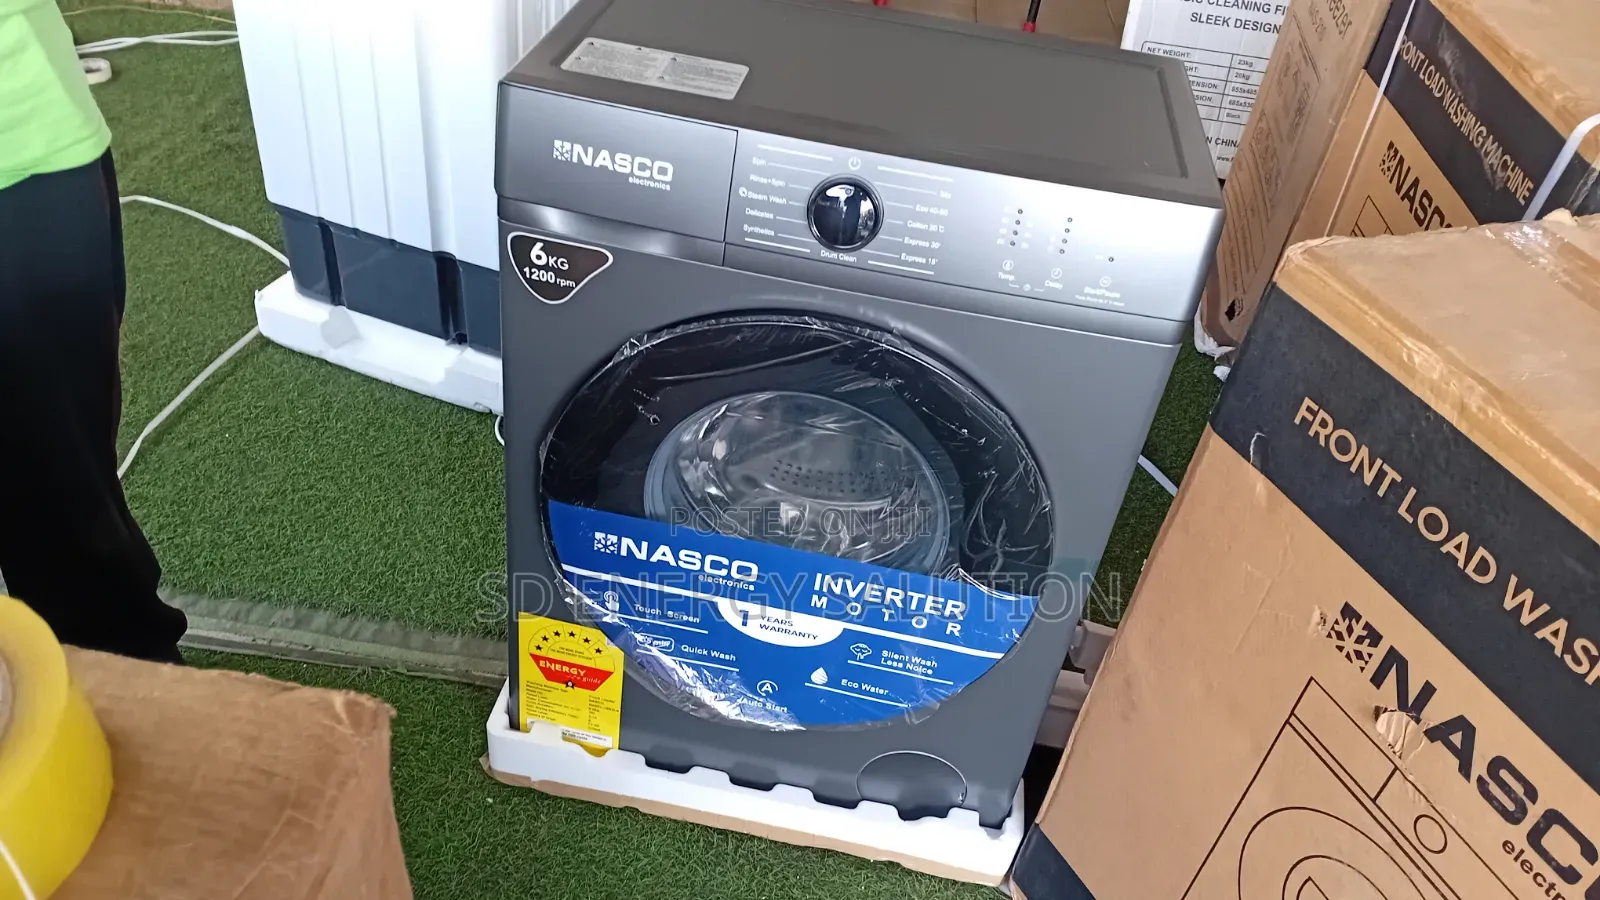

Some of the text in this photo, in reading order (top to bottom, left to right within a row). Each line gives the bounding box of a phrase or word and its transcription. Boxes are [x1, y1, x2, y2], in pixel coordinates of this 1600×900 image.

[1274, 5, 1290, 16] FI
[1190, 12, 1282, 35] SLEEK DESIGN
[1146, 46, 1162, 54] NET
[1237, 59, 1254, 68] 23kg
[1189, 80, 1219, 90] ENSION:
[1397, 34, 1535, 206] RONT LOAD WASHING MACHINE
[1215, 137, 1240, 149] CHIN
[571, 143, 674, 182] NASCO
[752, 156, 767, 167] Spin
[628, 176, 671, 191] electronics
[1389, 153, 1454, 231] NASC
[746, 190, 787, 205] Steam Wash
[745, 207, 774, 220] Delicates
[742, 223, 775, 237] Synthetics
[906, 220, 929, 230] Cotton
[903, 236, 930, 248] Express
[820, 249, 858, 263] Drum Clean
[900, 252, 927, 264] Express
[1292, 395, 1403, 500] FRONT
[1396, 488, 1498, 585] LOAD
[620, 536, 759, 583] NASCO
[698, 573, 755, 591] electronics
[814, 572, 967, 621] INVERTER
[633, 603, 700, 624] Touch Screen
[739, 609, 794, 627] 1 YEARS
[758, 623, 819, 642] WARRANTY
[681, 644, 736, 662] Quick Wash
[882, 650, 938, 669] Silent Wash
[539, 660, 587, 677] ENERGY
[881, 657, 933, 676] Less Noice
[841, 678, 889, 697] Eco Water
[766, 702, 788, 714] Start
[1369, 644, 1600, 900] NASC
